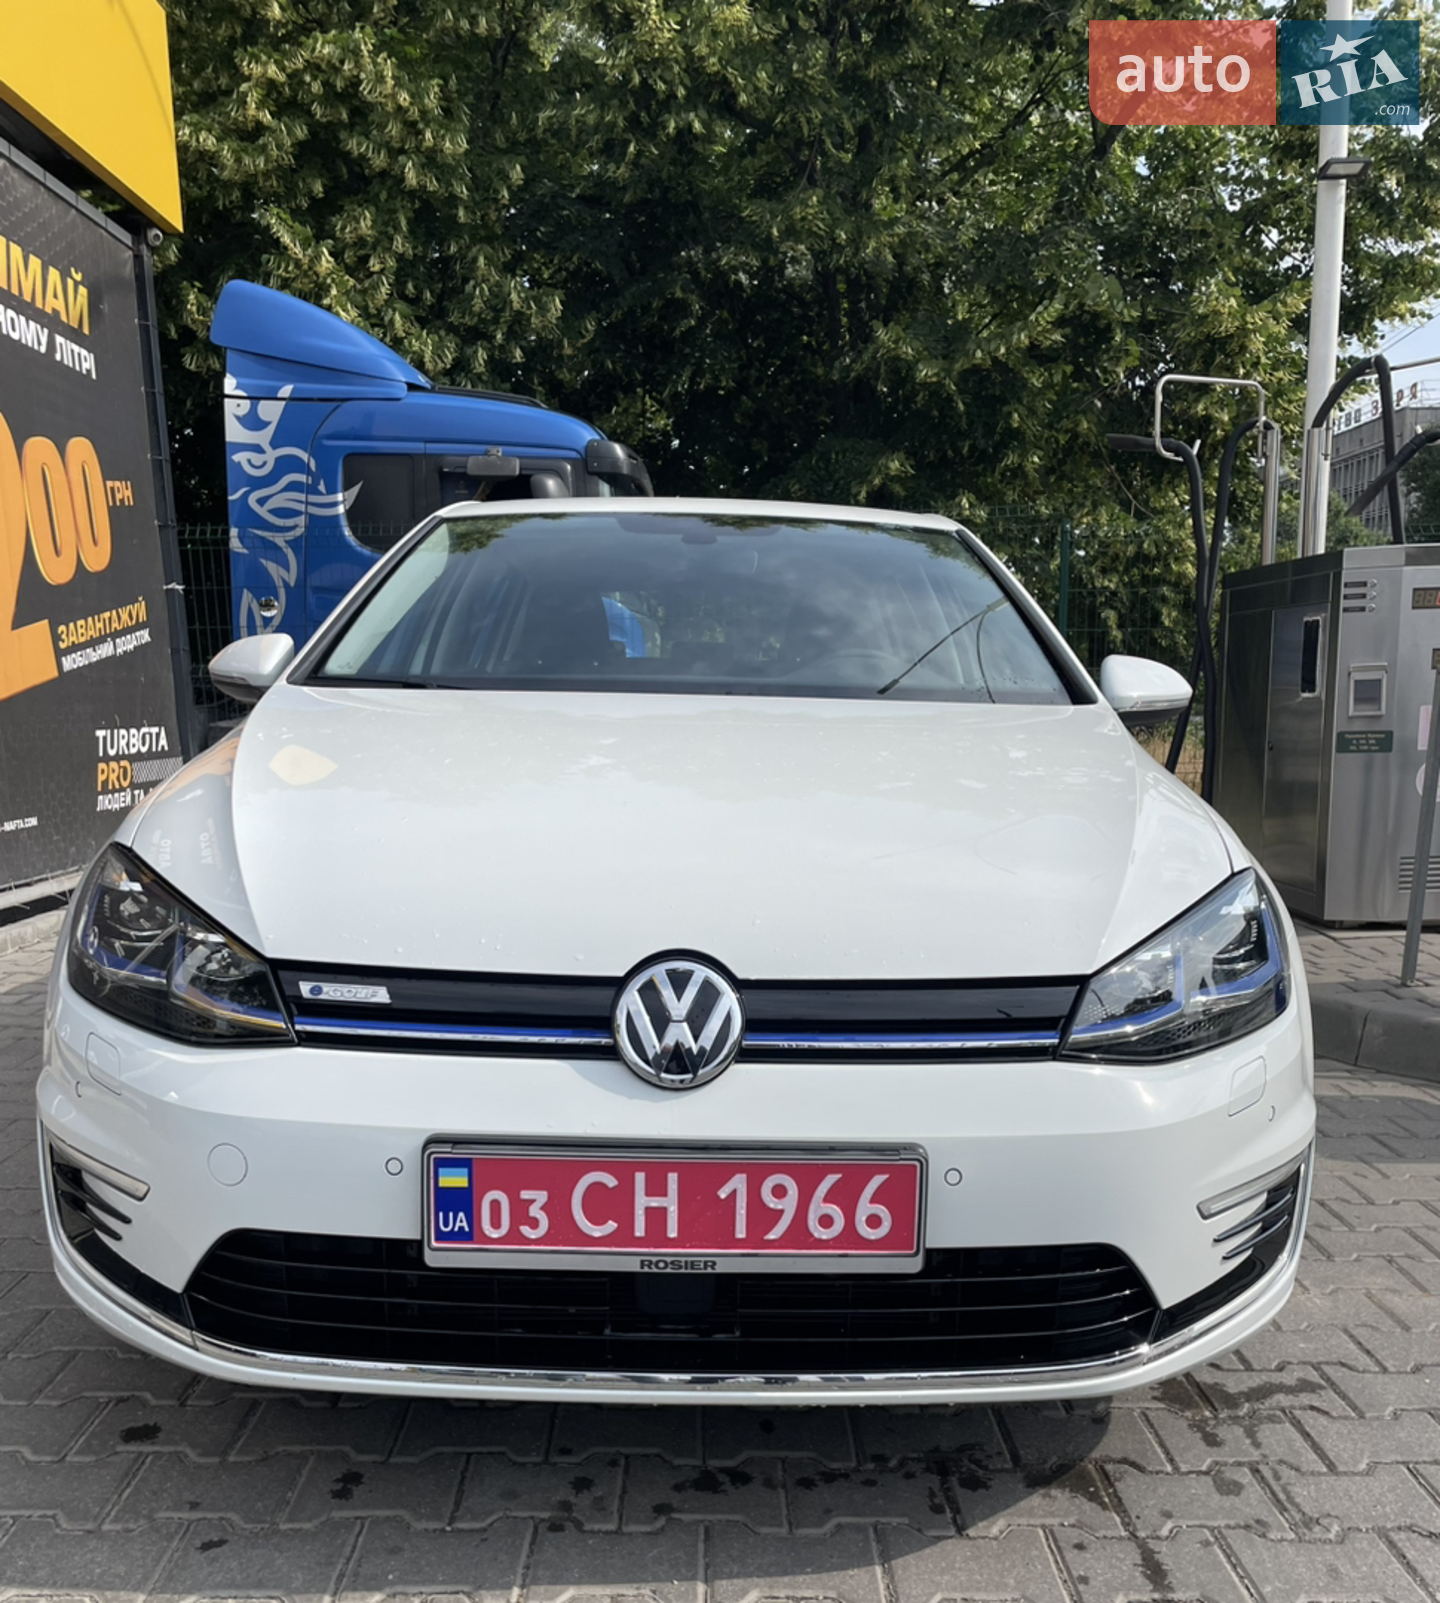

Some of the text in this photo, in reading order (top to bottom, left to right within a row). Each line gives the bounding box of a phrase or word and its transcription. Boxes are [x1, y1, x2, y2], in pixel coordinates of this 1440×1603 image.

[55, 333, 97, 380] ЛІТРІ
[106, 480, 134, 506] ГРН
[57, 595, 147, 650] ЗАВАНТАЖУЙ
[61, 628, 152, 673] МОБІЛЬНИЙ ДОДАТОК
[95, 726, 168, 757] TURBOTA
[97, 760, 132, 791] PRO
[96, 788, 131, 812] ЛЮДЕЙ
[0, 815, 38, 832] -NAFTA.COM
[438, 1170, 893, 1242] UA 03 CH 1966
[639, 1259, 718, 1272] ROSIER
